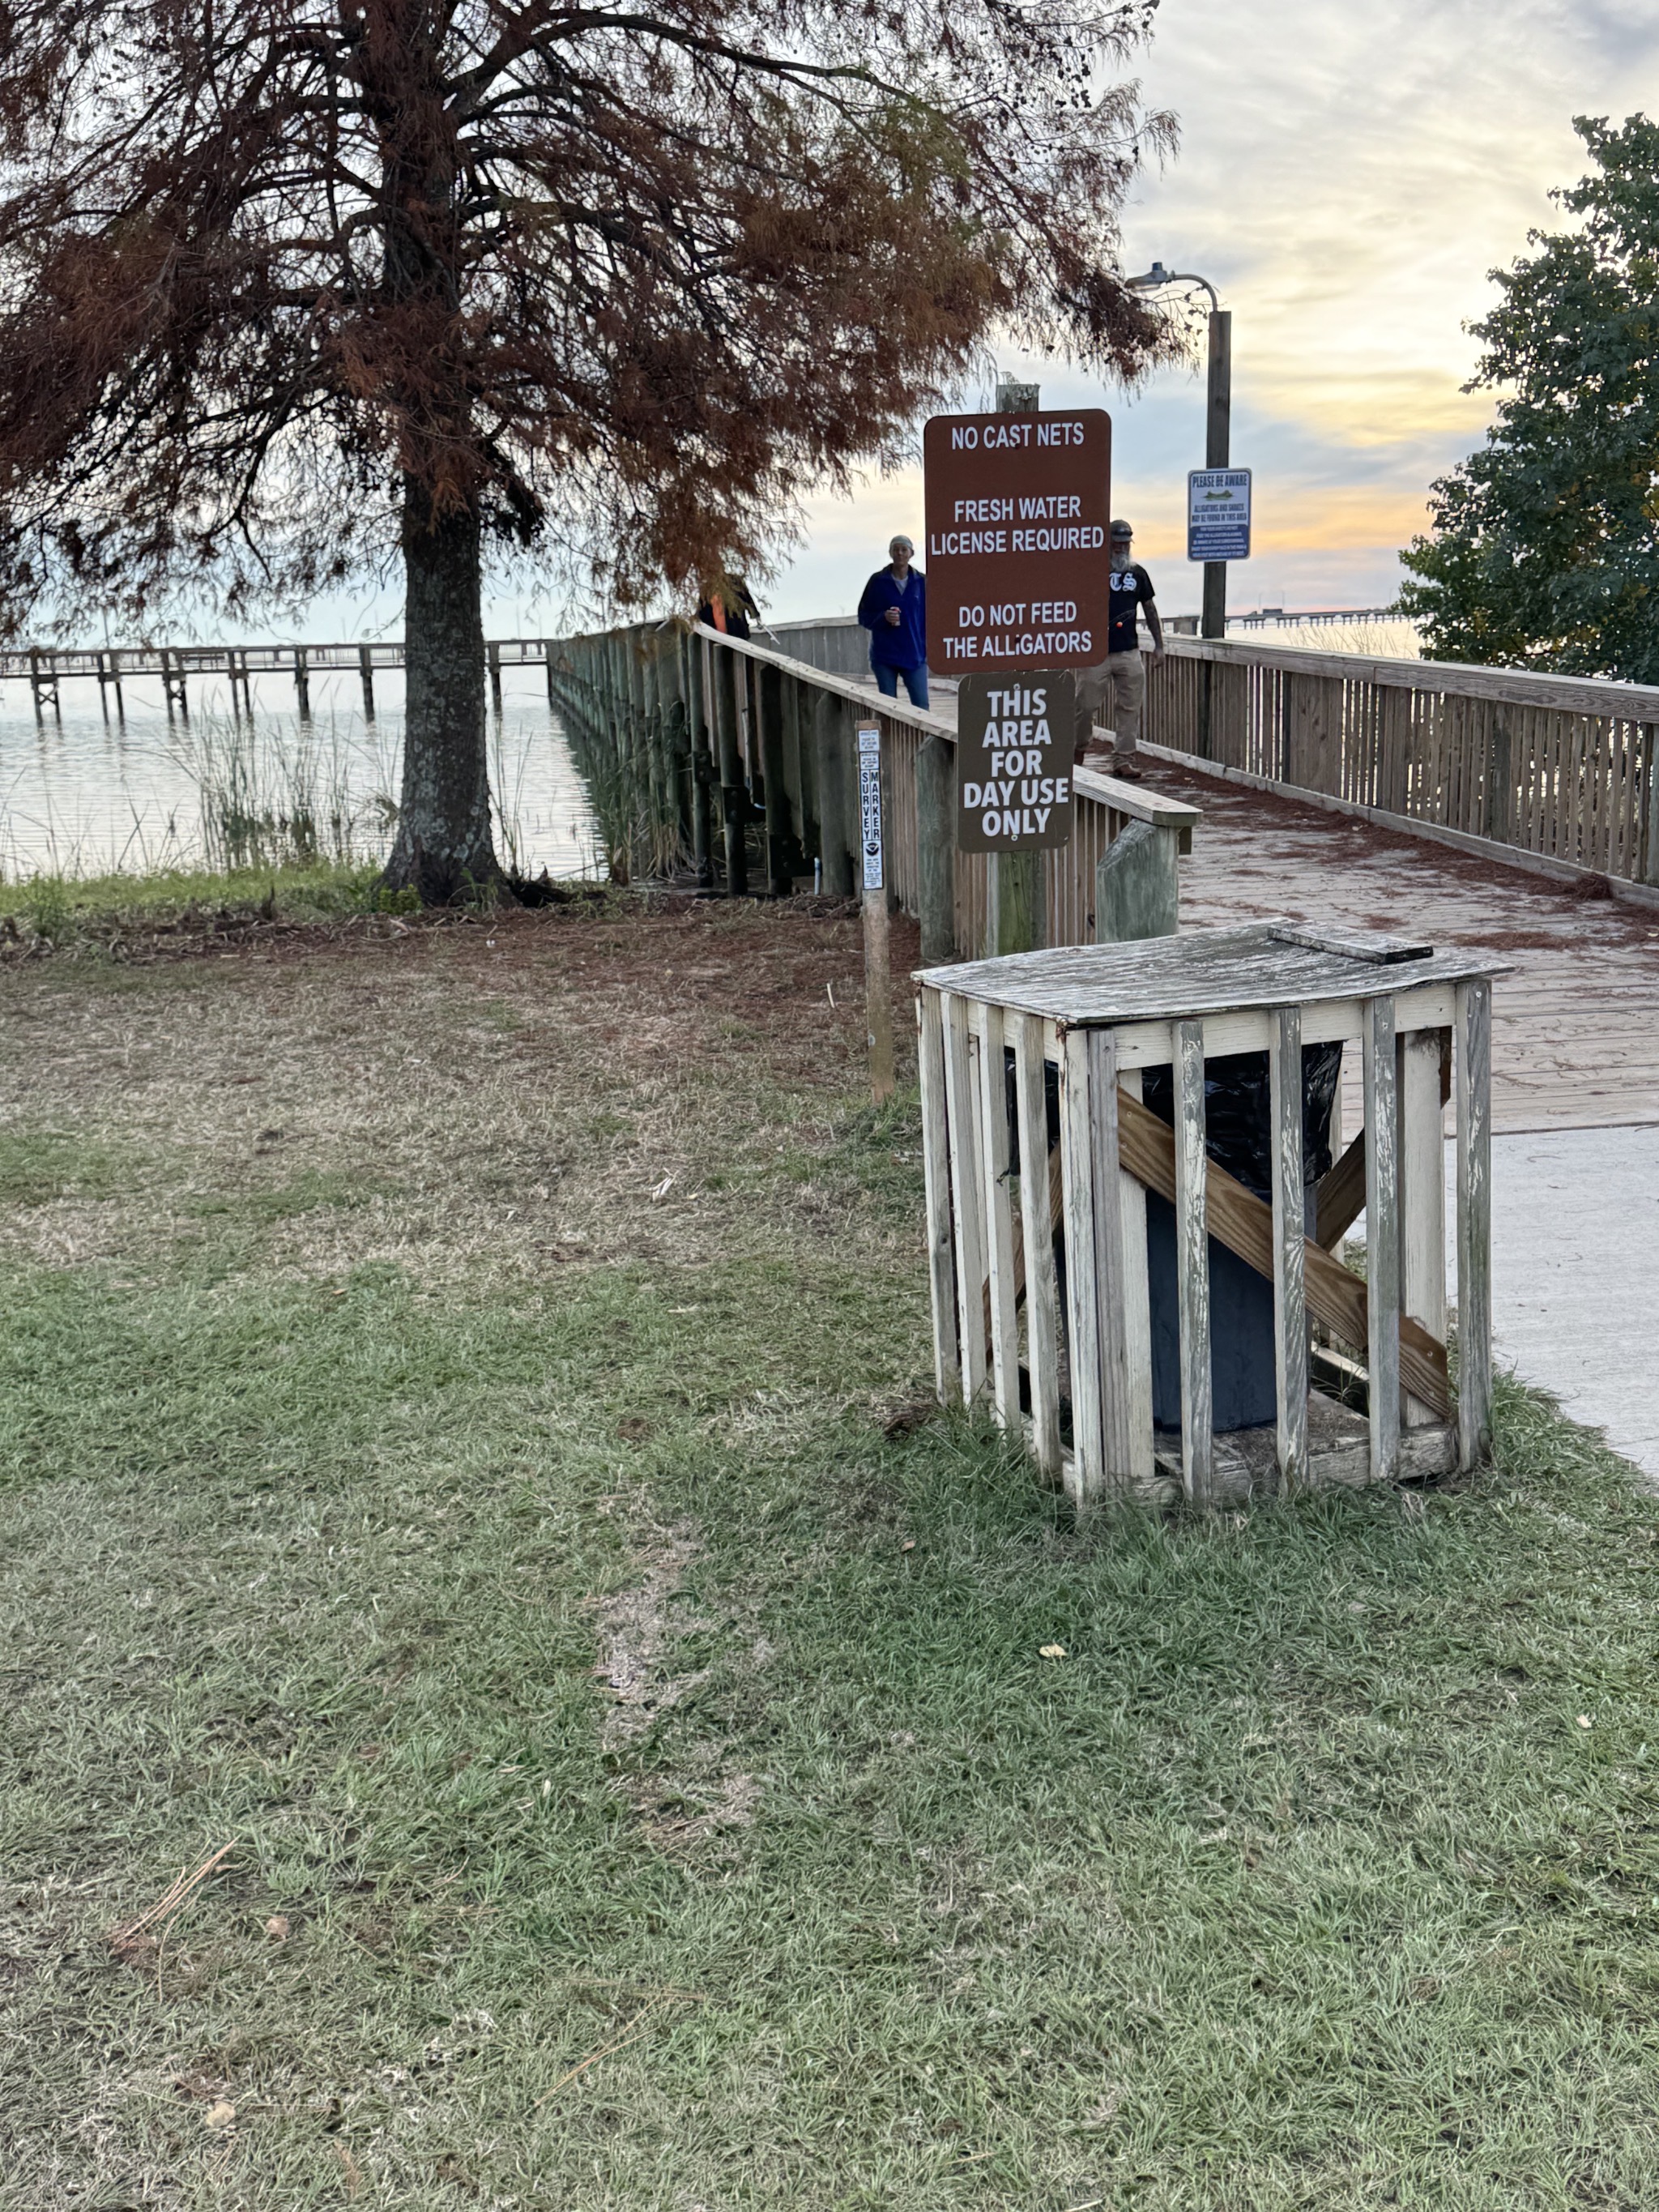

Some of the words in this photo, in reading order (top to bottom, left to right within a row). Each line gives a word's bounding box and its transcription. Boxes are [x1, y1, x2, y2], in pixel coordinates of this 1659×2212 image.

[952, 427, 978, 450] NO
[983, 424, 1032, 448] CAST
[1037, 422, 1084, 446] NETS
[1192, 475, 1214, 488] PLEASE
[1216, 475, 1224, 487] BE
[1225, 474, 1247, 487] AWARE
[954, 498, 1013, 523] FRESH
[1019, 496, 1081, 520] WATER
[932, 531, 1006, 555] LICENSE
[1013, 527, 1104, 552] REQUIRED
[959, 605, 984, 627] DO
[990, 604, 1026, 626] NOT
[1031, 601, 1077, 624] FEED
[943, 636, 977, 658] THE
[982, 631, 1092, 657] ALLIGATORS
[987, 689, 1047, 717] THIS
[982, 719, 1051, 748] AREA
[992, 749, 1043, 778] FOR
[862, 772, 870, 839] SURVEY
[871, 771, 880, 839] MARKER
[964, 780, 1015, 809] DAY
[1021, 778, 1068, 805] USE
[982, 808, 1051, 837] ONLY
